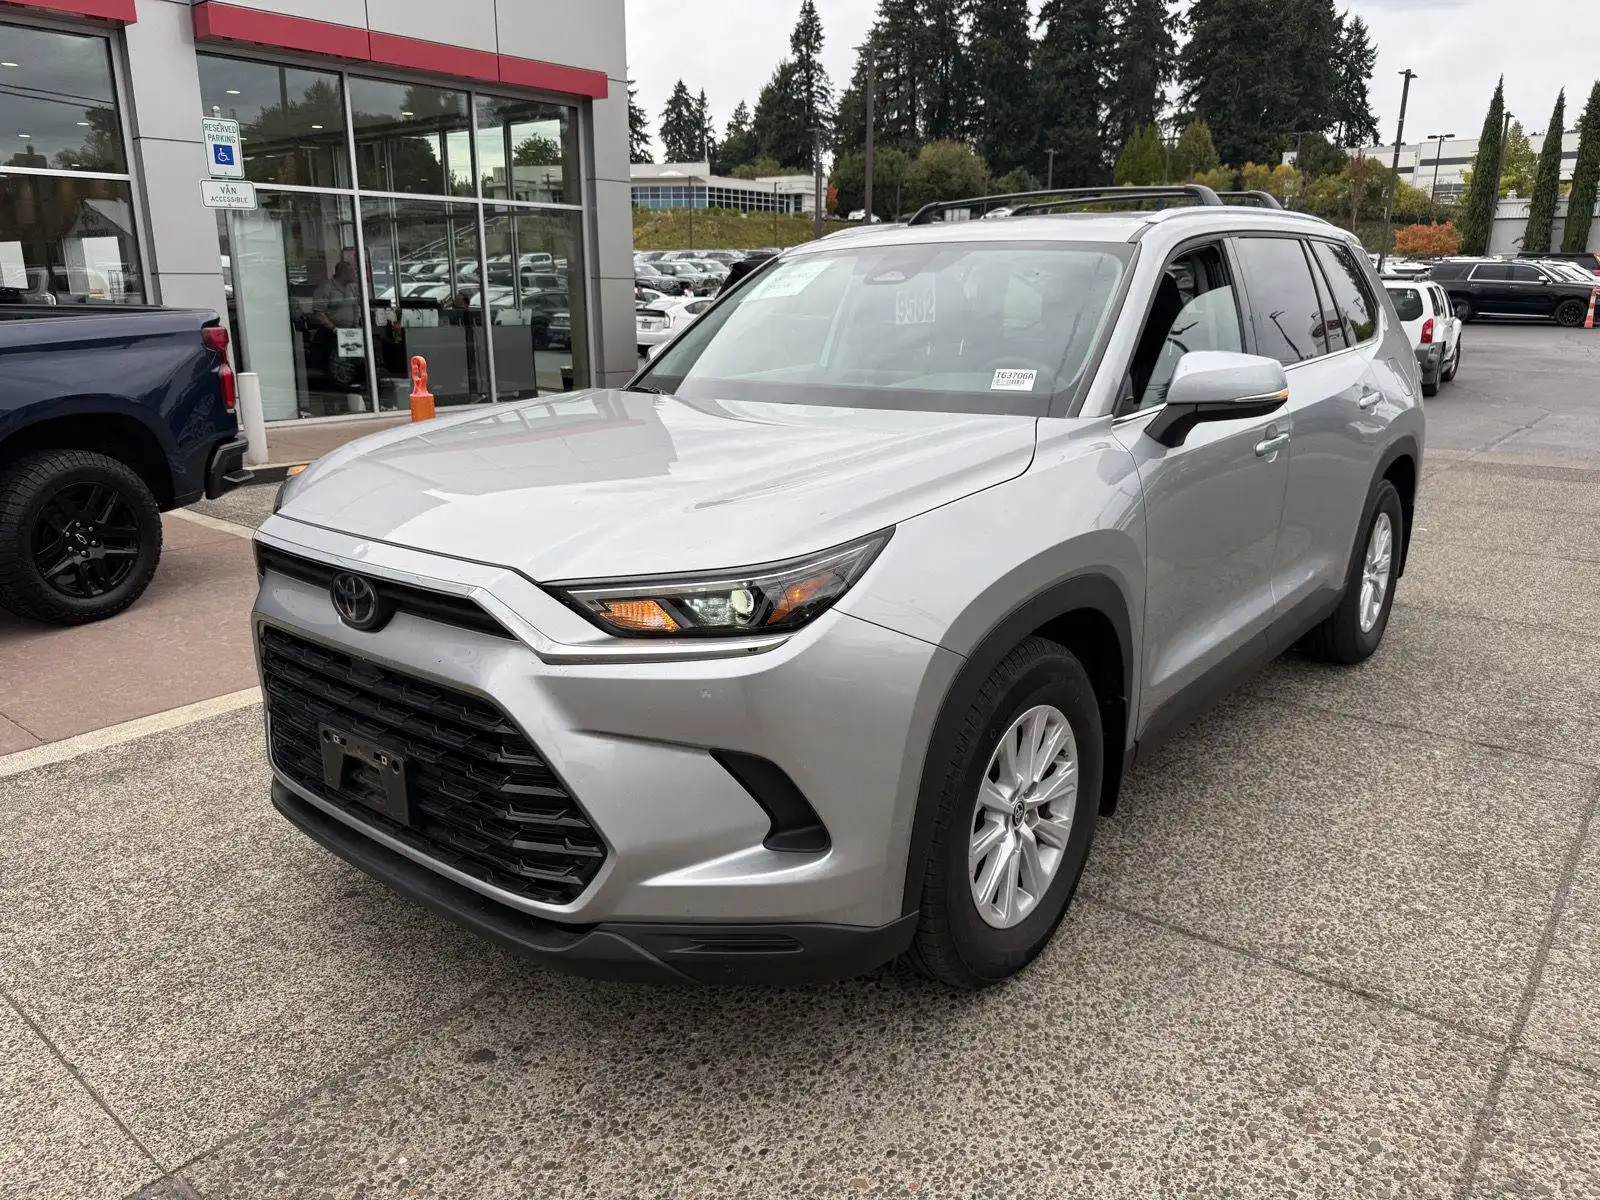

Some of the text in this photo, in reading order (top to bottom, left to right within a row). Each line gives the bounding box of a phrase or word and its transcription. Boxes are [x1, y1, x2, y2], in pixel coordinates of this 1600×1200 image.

[204, 123, 236, 133] RESERVED
[207, 133, 236, 143] PARKING
[220, 186, 237, 194] VAN
[211, 196, 248, 204] ACCESSIBLE
[996, 371, 1034, 380] T63706A
